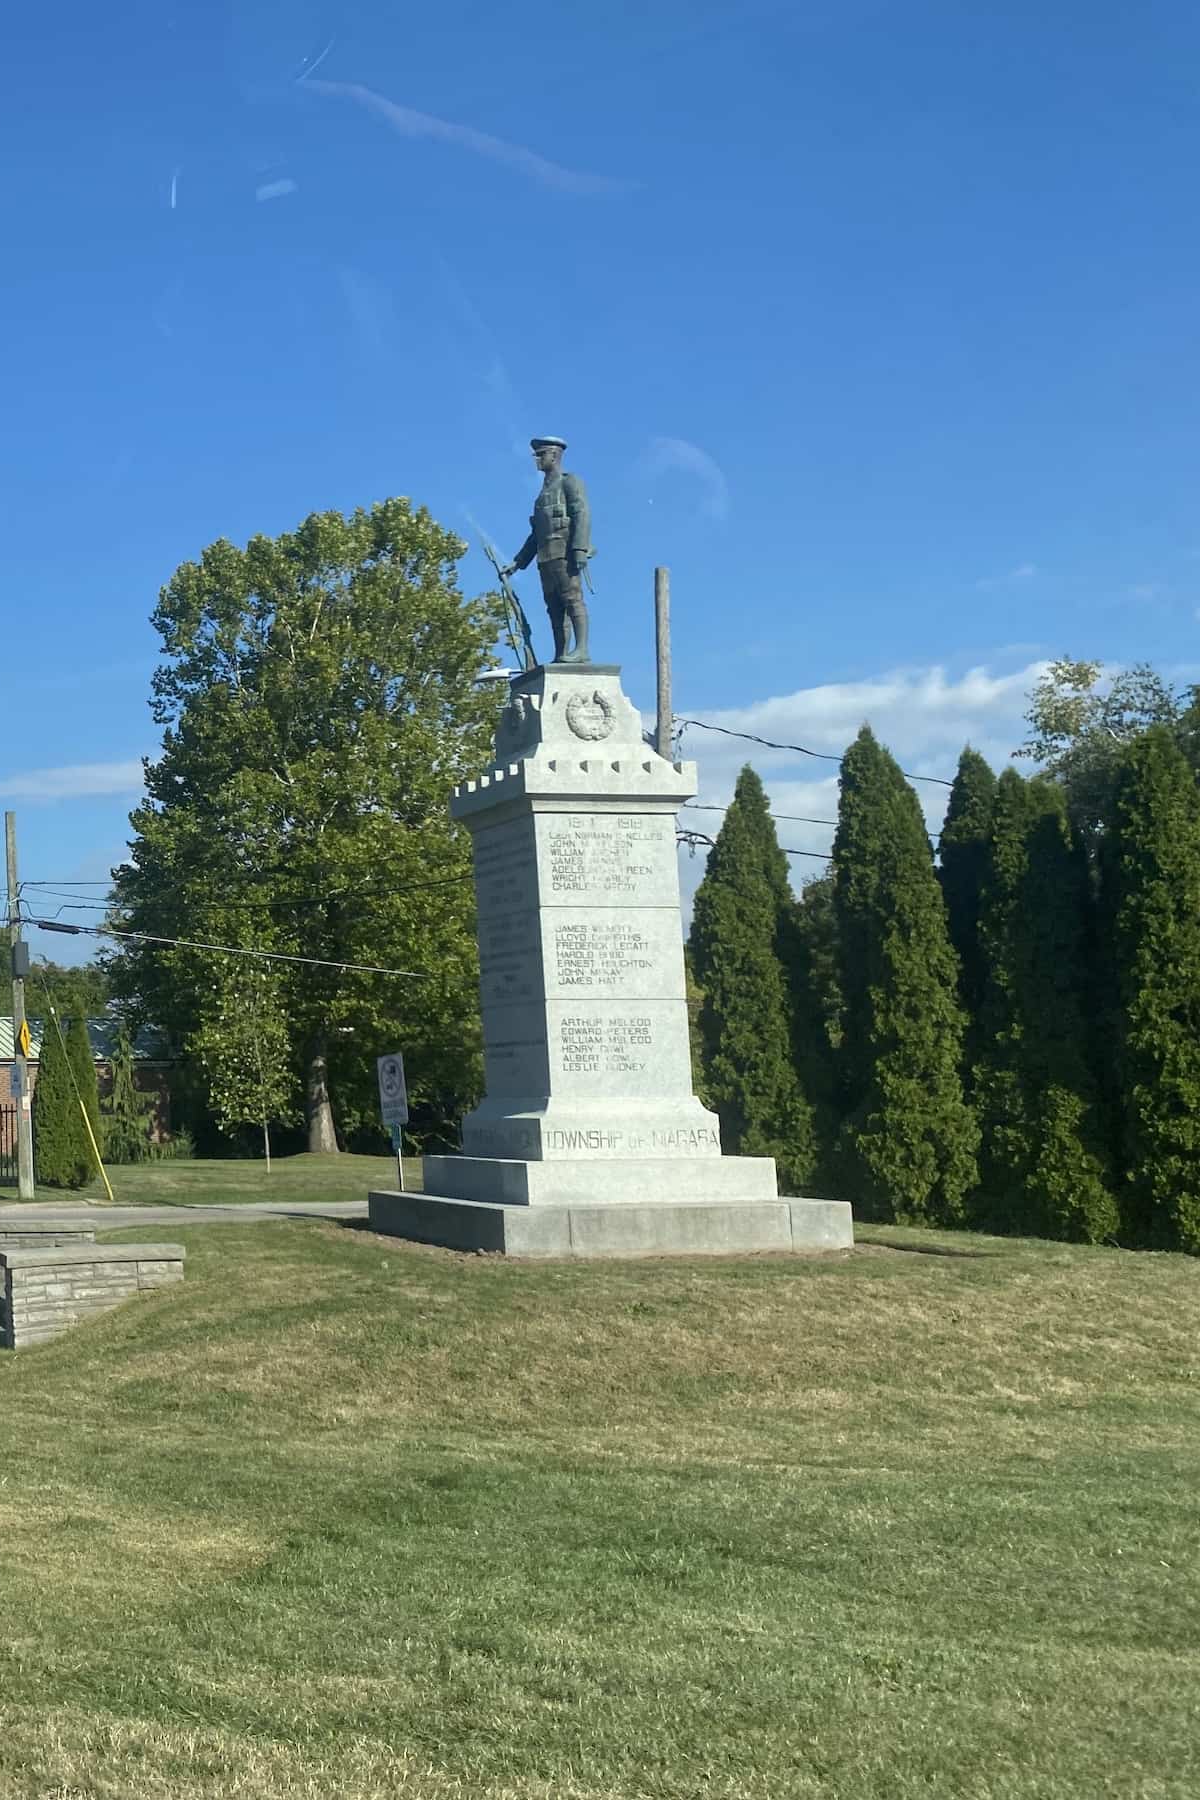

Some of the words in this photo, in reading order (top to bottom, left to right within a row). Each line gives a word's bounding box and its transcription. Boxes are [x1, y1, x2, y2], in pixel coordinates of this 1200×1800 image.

[550, 840, 575, 848] JOHN
[551, 849, 584, 857] WILLIAM
[551, 857, 583, 866] JAMES
[555, 924, 587, 932] JAMES
[555, 933, 587, 941] LLOYD
[556, 941, 608, 950] FREDERICK
[556, 951, 594, 959] HAROLD
[557, 959, 594, 968] ERNEST
[557, 968, 584, 976] JOHN
[558, 976, 592, 985] JAMES
[561, 1018, 602, 1027] ARTHUR
[561, 1027, 602, 1035] EDWARD
[561, 1036, 602, 1044] WILLIAM
[562, 1045, 593, 1053] HENRY
[563, 1054, 599, 1062] ALBERT
[563, 1063, 599, 1072] LESLIE
[544, 1130, 622, 1149] TOWNSHIP
[652, 1129, 720, 1148] NIAGARA
